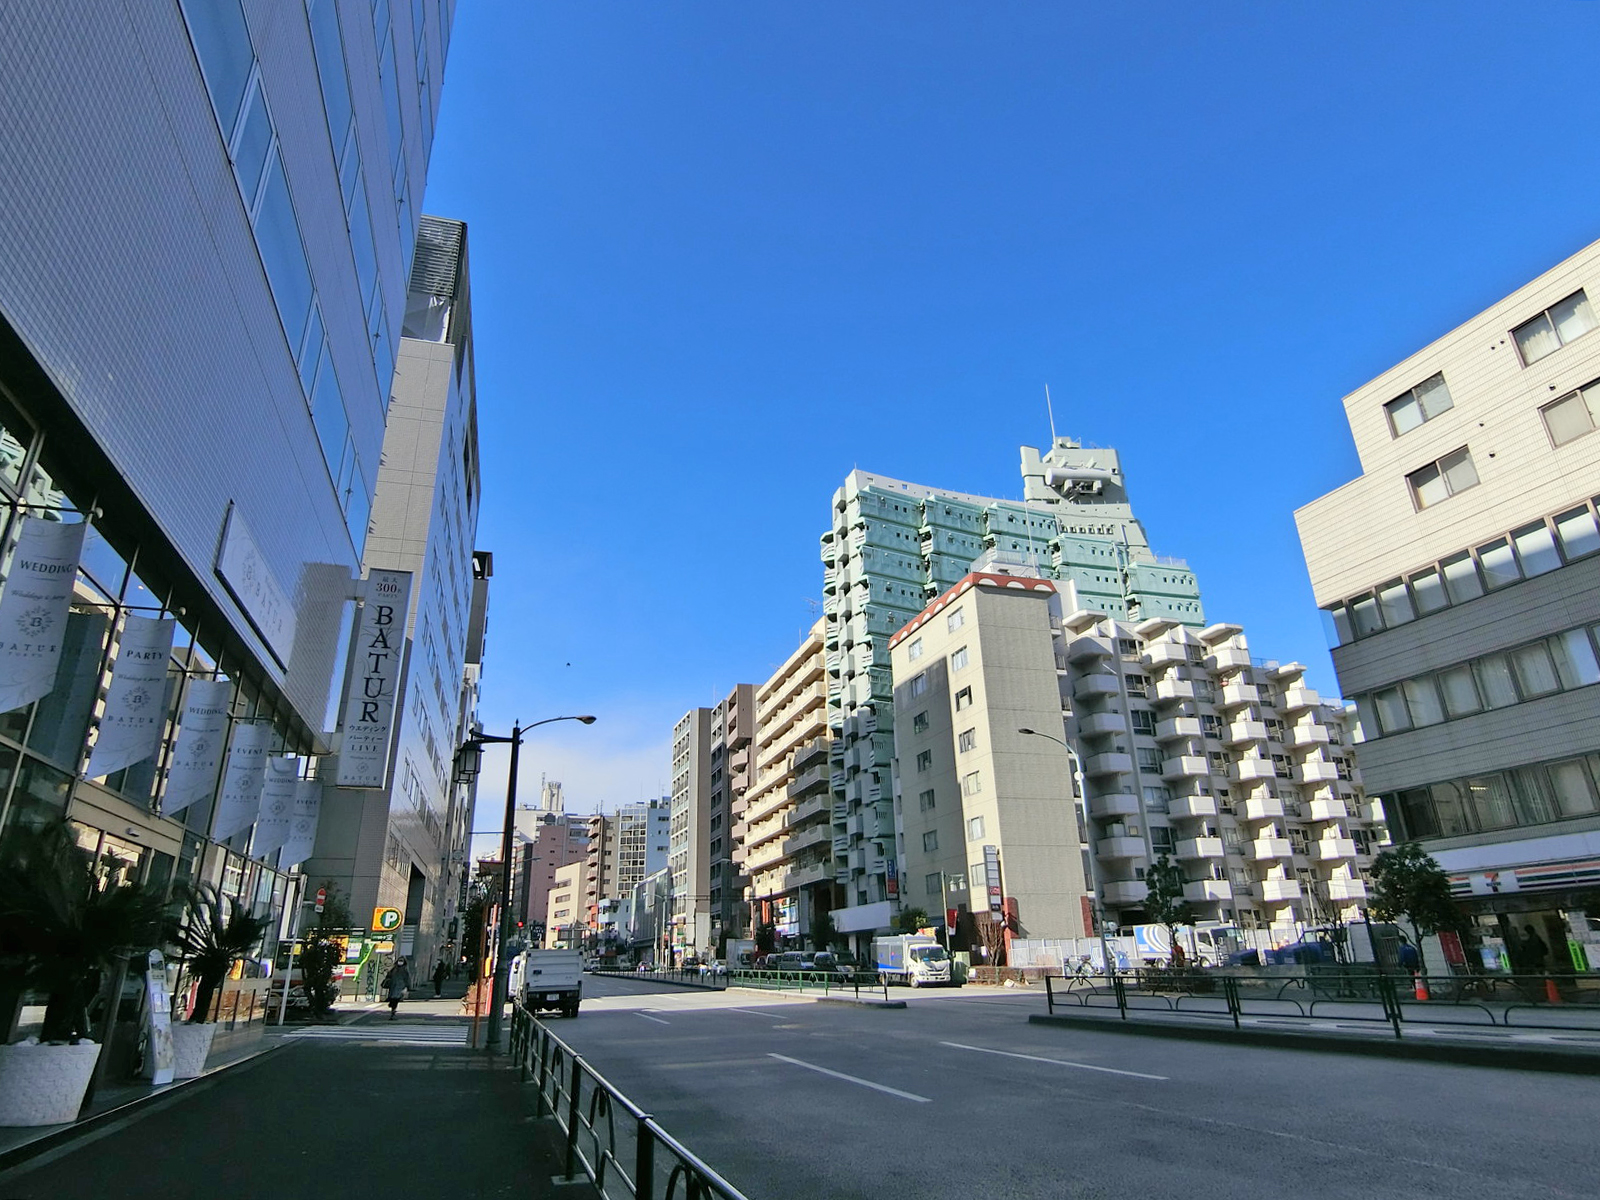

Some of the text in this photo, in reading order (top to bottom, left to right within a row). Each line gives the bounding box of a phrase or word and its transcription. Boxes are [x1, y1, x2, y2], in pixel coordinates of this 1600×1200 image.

[20, 560, 73, 574] WEDDING
[126, 650, 163, 660] PARTY
[359, 605, 393, 723] BATUR
[350, 744, 378, 752] LIVE
[384, 911, 398, 927] P
